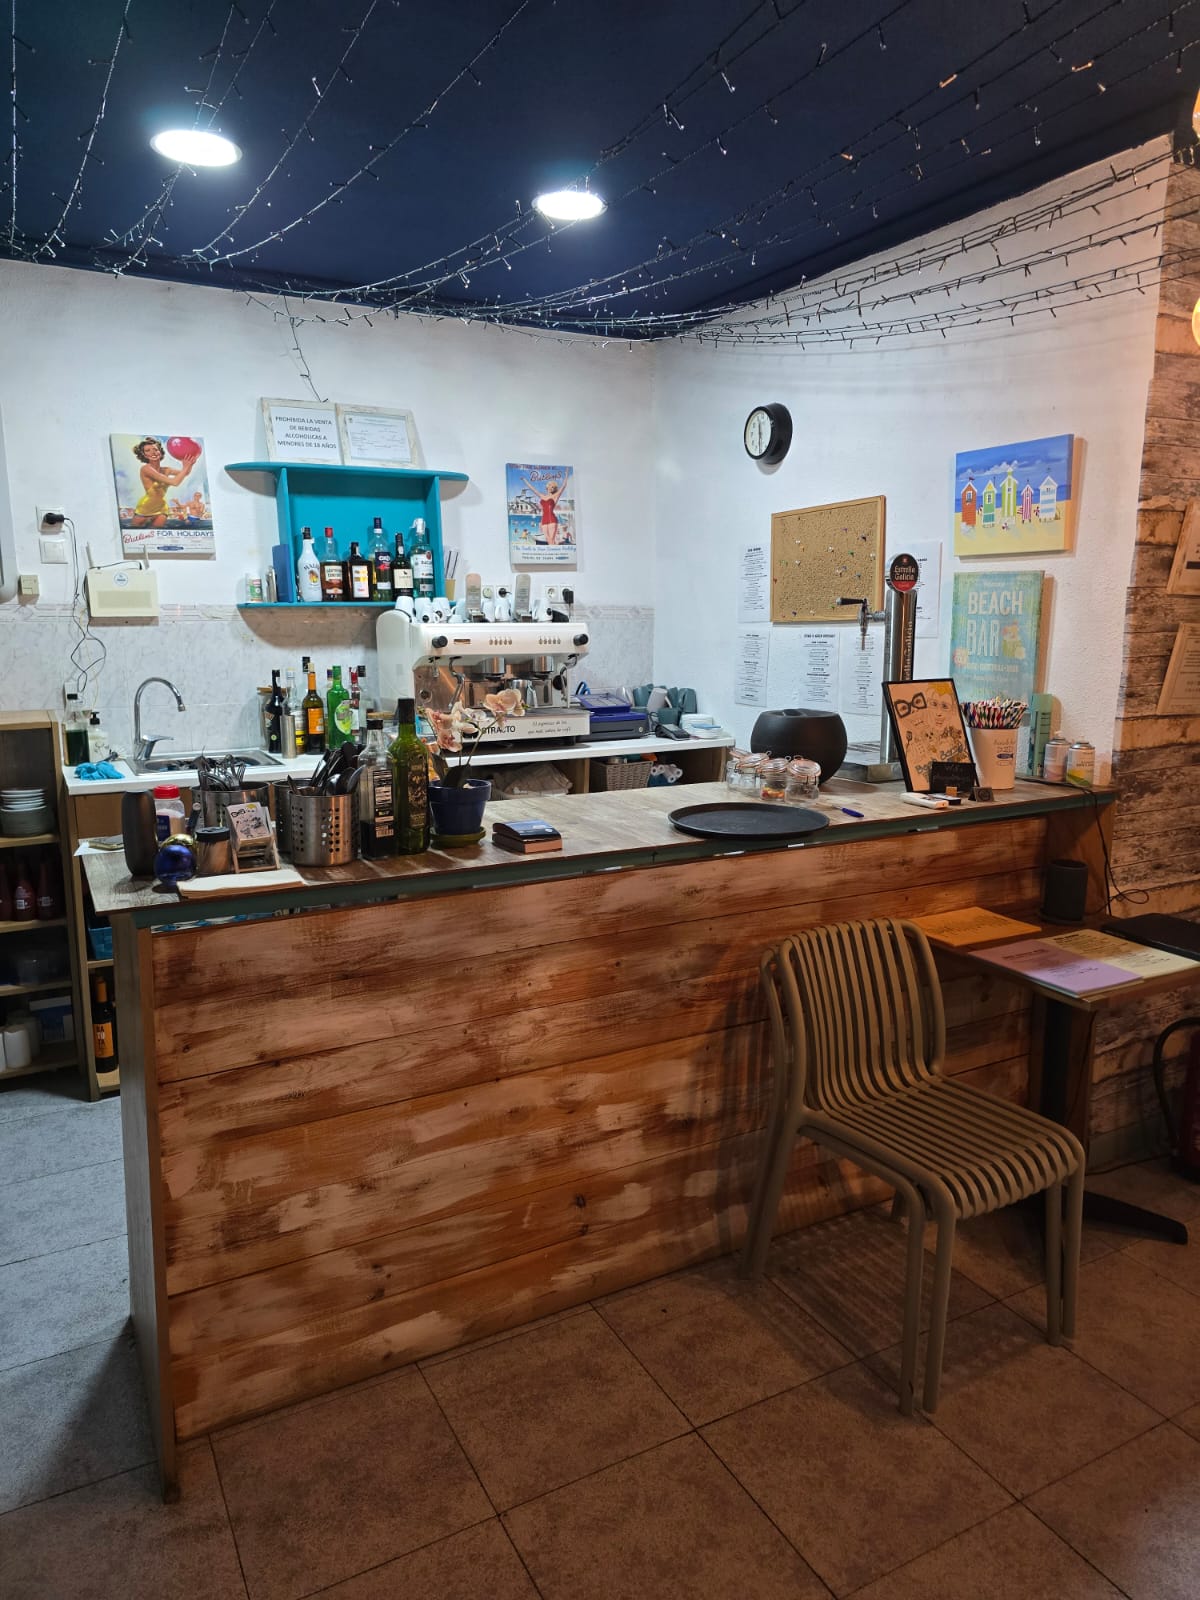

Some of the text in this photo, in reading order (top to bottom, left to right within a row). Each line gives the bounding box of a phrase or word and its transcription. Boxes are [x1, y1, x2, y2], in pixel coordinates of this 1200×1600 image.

[275, 416, 306, 424] PROHIBIDA
[322, 441, 337, 449] AÑOS
[894, 565, 916, 573] Estrella
[968, 590, 1024, 615] BEACH
[966, 620, 1000, 657] BAR
